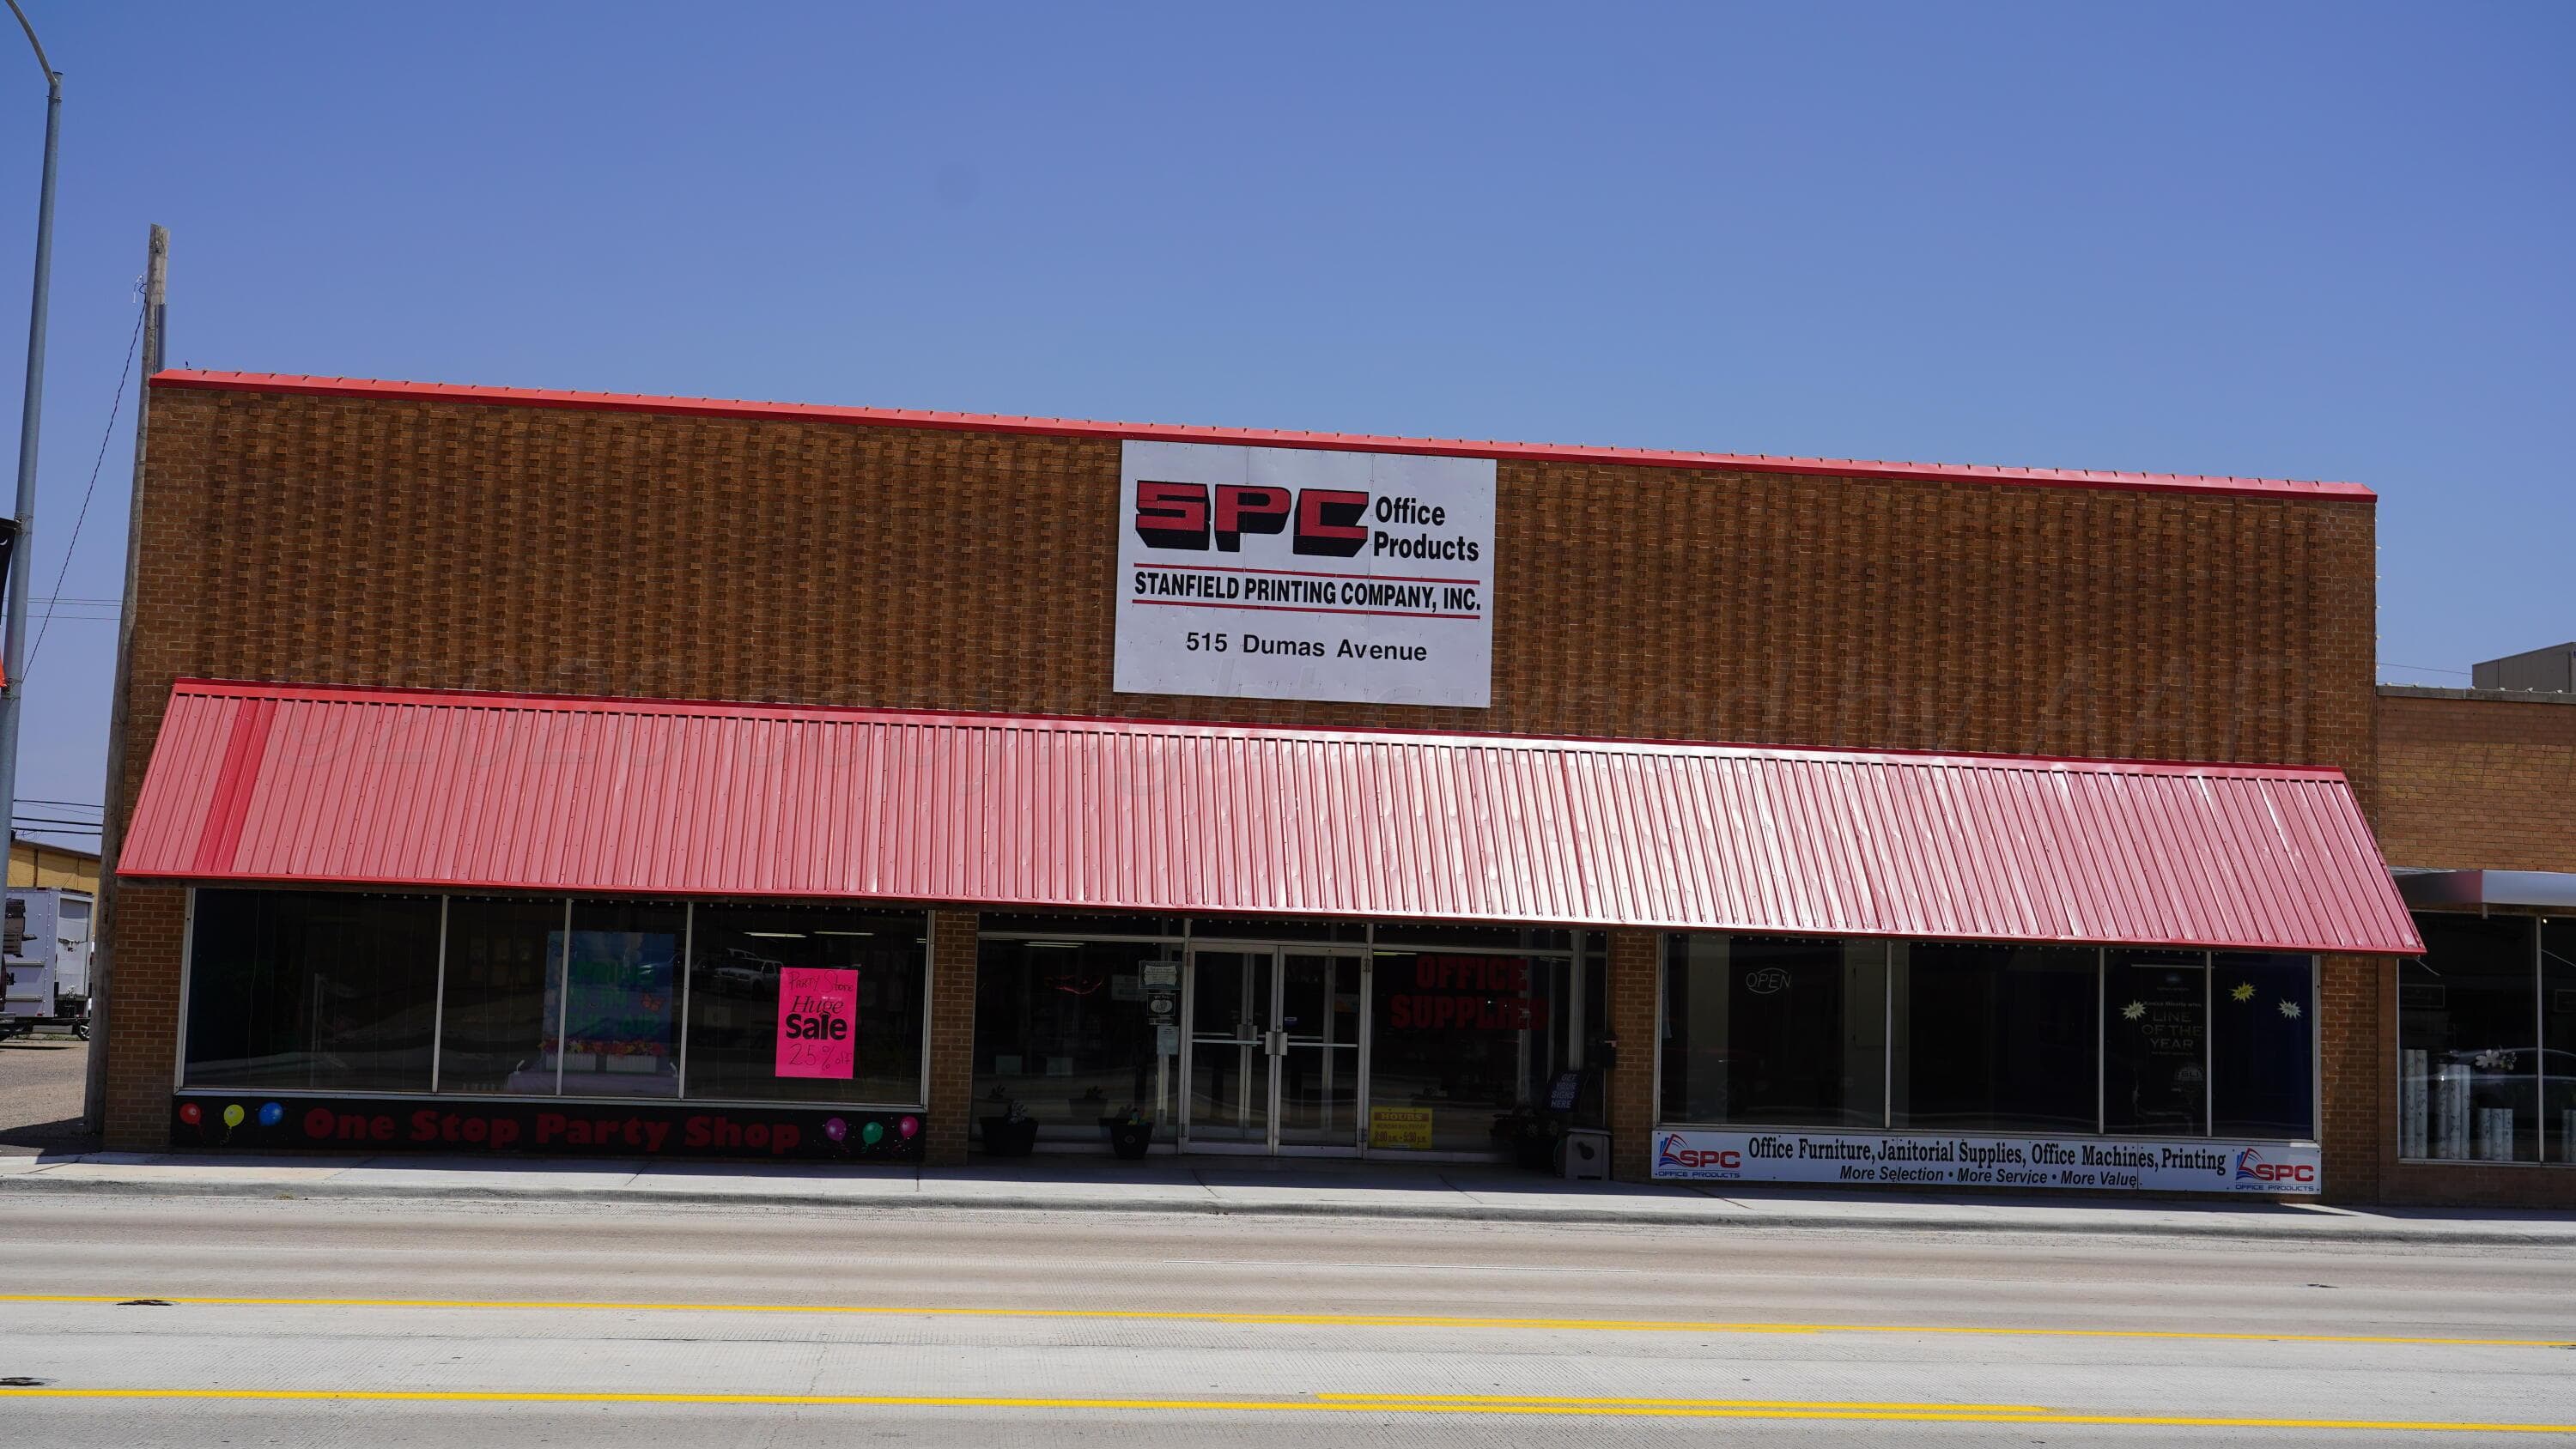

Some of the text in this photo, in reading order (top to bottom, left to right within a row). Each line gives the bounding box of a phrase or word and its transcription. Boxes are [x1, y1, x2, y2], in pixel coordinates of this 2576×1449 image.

[1135, 479, 1370, 557] SPC
[1375, 495, 1445, 526] Office
[1373, 530, 1479, 561] Products
[1134, 571, 1481, 613] STANFIELD PRINTING COMPANY, INC.
[1186, 631, 1427, 662] 515 Dumas Avenue
[1414, 954, 1528, 991] OFFICE
[1745, 972, 1791, 990] OPEN
[792, 995, 845, 1017] Huge
[1389, 991, 1548, 1030] SUPPLIES
[2153, 1009, 2191, 1022] LINE
[786, 1013, 848, 1040] Sale
[2142, 1023, 2204, 1037] OF THE
[788, 1043, 837, 1071] 25%
[2149, 1037, 2194, 1050] YEAR
[1551, 1099, 1572, 1109] HERE
[303, 1106, 801, 1155] One Stop Party Shop
[1680, 1149, 1741, 1168] SPC
[1748, 1137, 2226, 1175] Office Furniture, Janitorial Supplies, Office Machines, Printing
[1692, 1170, 1741, 1179] PRODUCTS
[1839, 1165, 1876, 1180] More
[1879, 1166, 1944, 1182] Selection
[1957, 1167, 1993, 1183] More
[1996, 1168, 2048, 1185] Service
[2061, 1170, 2094, 1186] More
[2258, 1163, 2314, 1182] SPC
